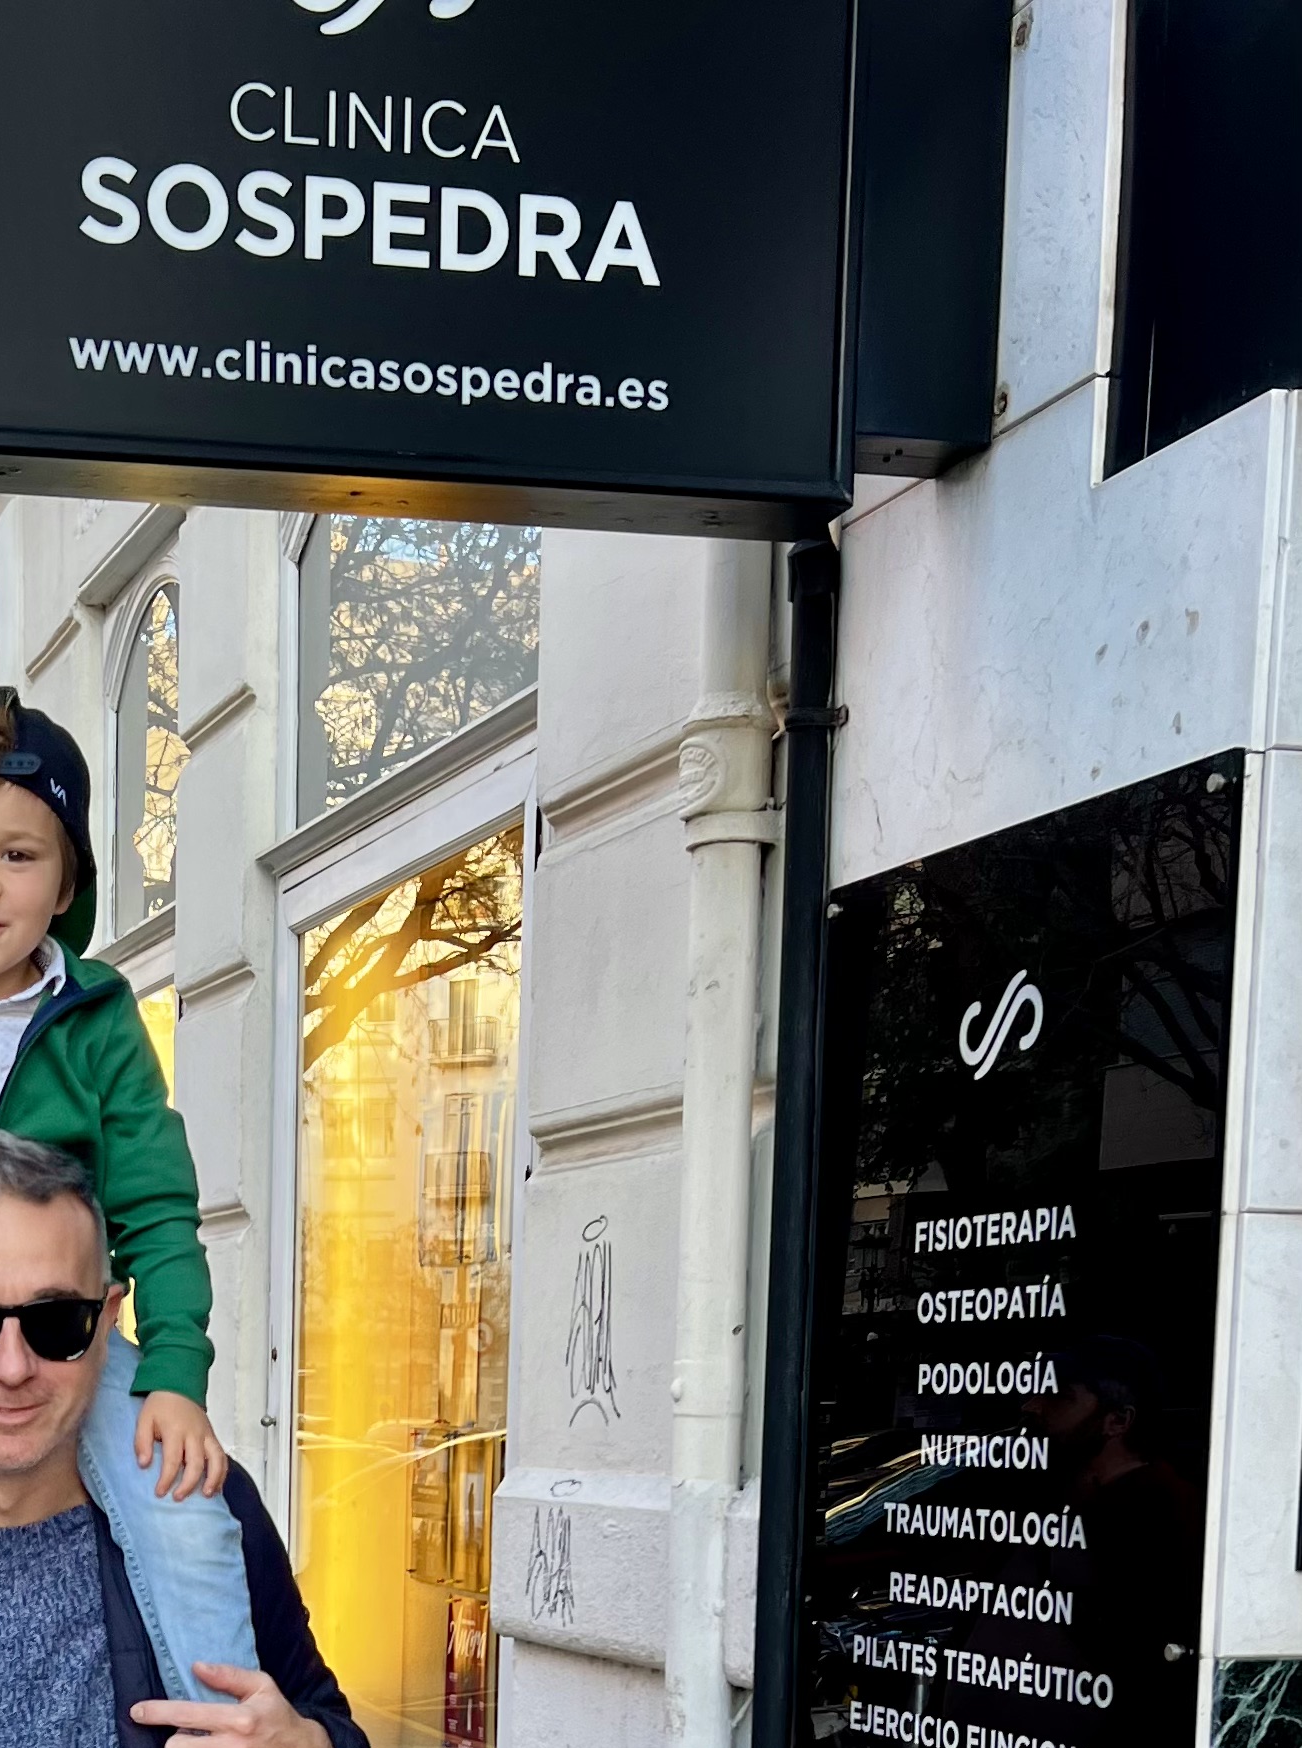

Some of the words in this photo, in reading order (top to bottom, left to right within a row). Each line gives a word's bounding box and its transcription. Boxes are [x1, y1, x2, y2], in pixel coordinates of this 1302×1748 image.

[230, 82, 521, 164] CLINICA
[79, 156, 661, 287] SOSPEDRA
[68, 337, 669, 411] www.clinicasospedra.es
[914, 1204, 1077, 1254] FISIOTERAPIA
[916, 1274, 1066, 1324] OSTEOPATÍA
[917, 1351, 1059, 1395] PODOLOGÍA
[919, 1427, 1049, 1471] NUTRICIÓN
[882, 1500, 1087, 1550] TRAUMATOLOGÍA
[889, 1570, 1073, 1625] READAPTACIÓN
[852, 1634, 938, 1678] PILATES
[944, 1648, 1114, 1709] TERAPÉUTICO
